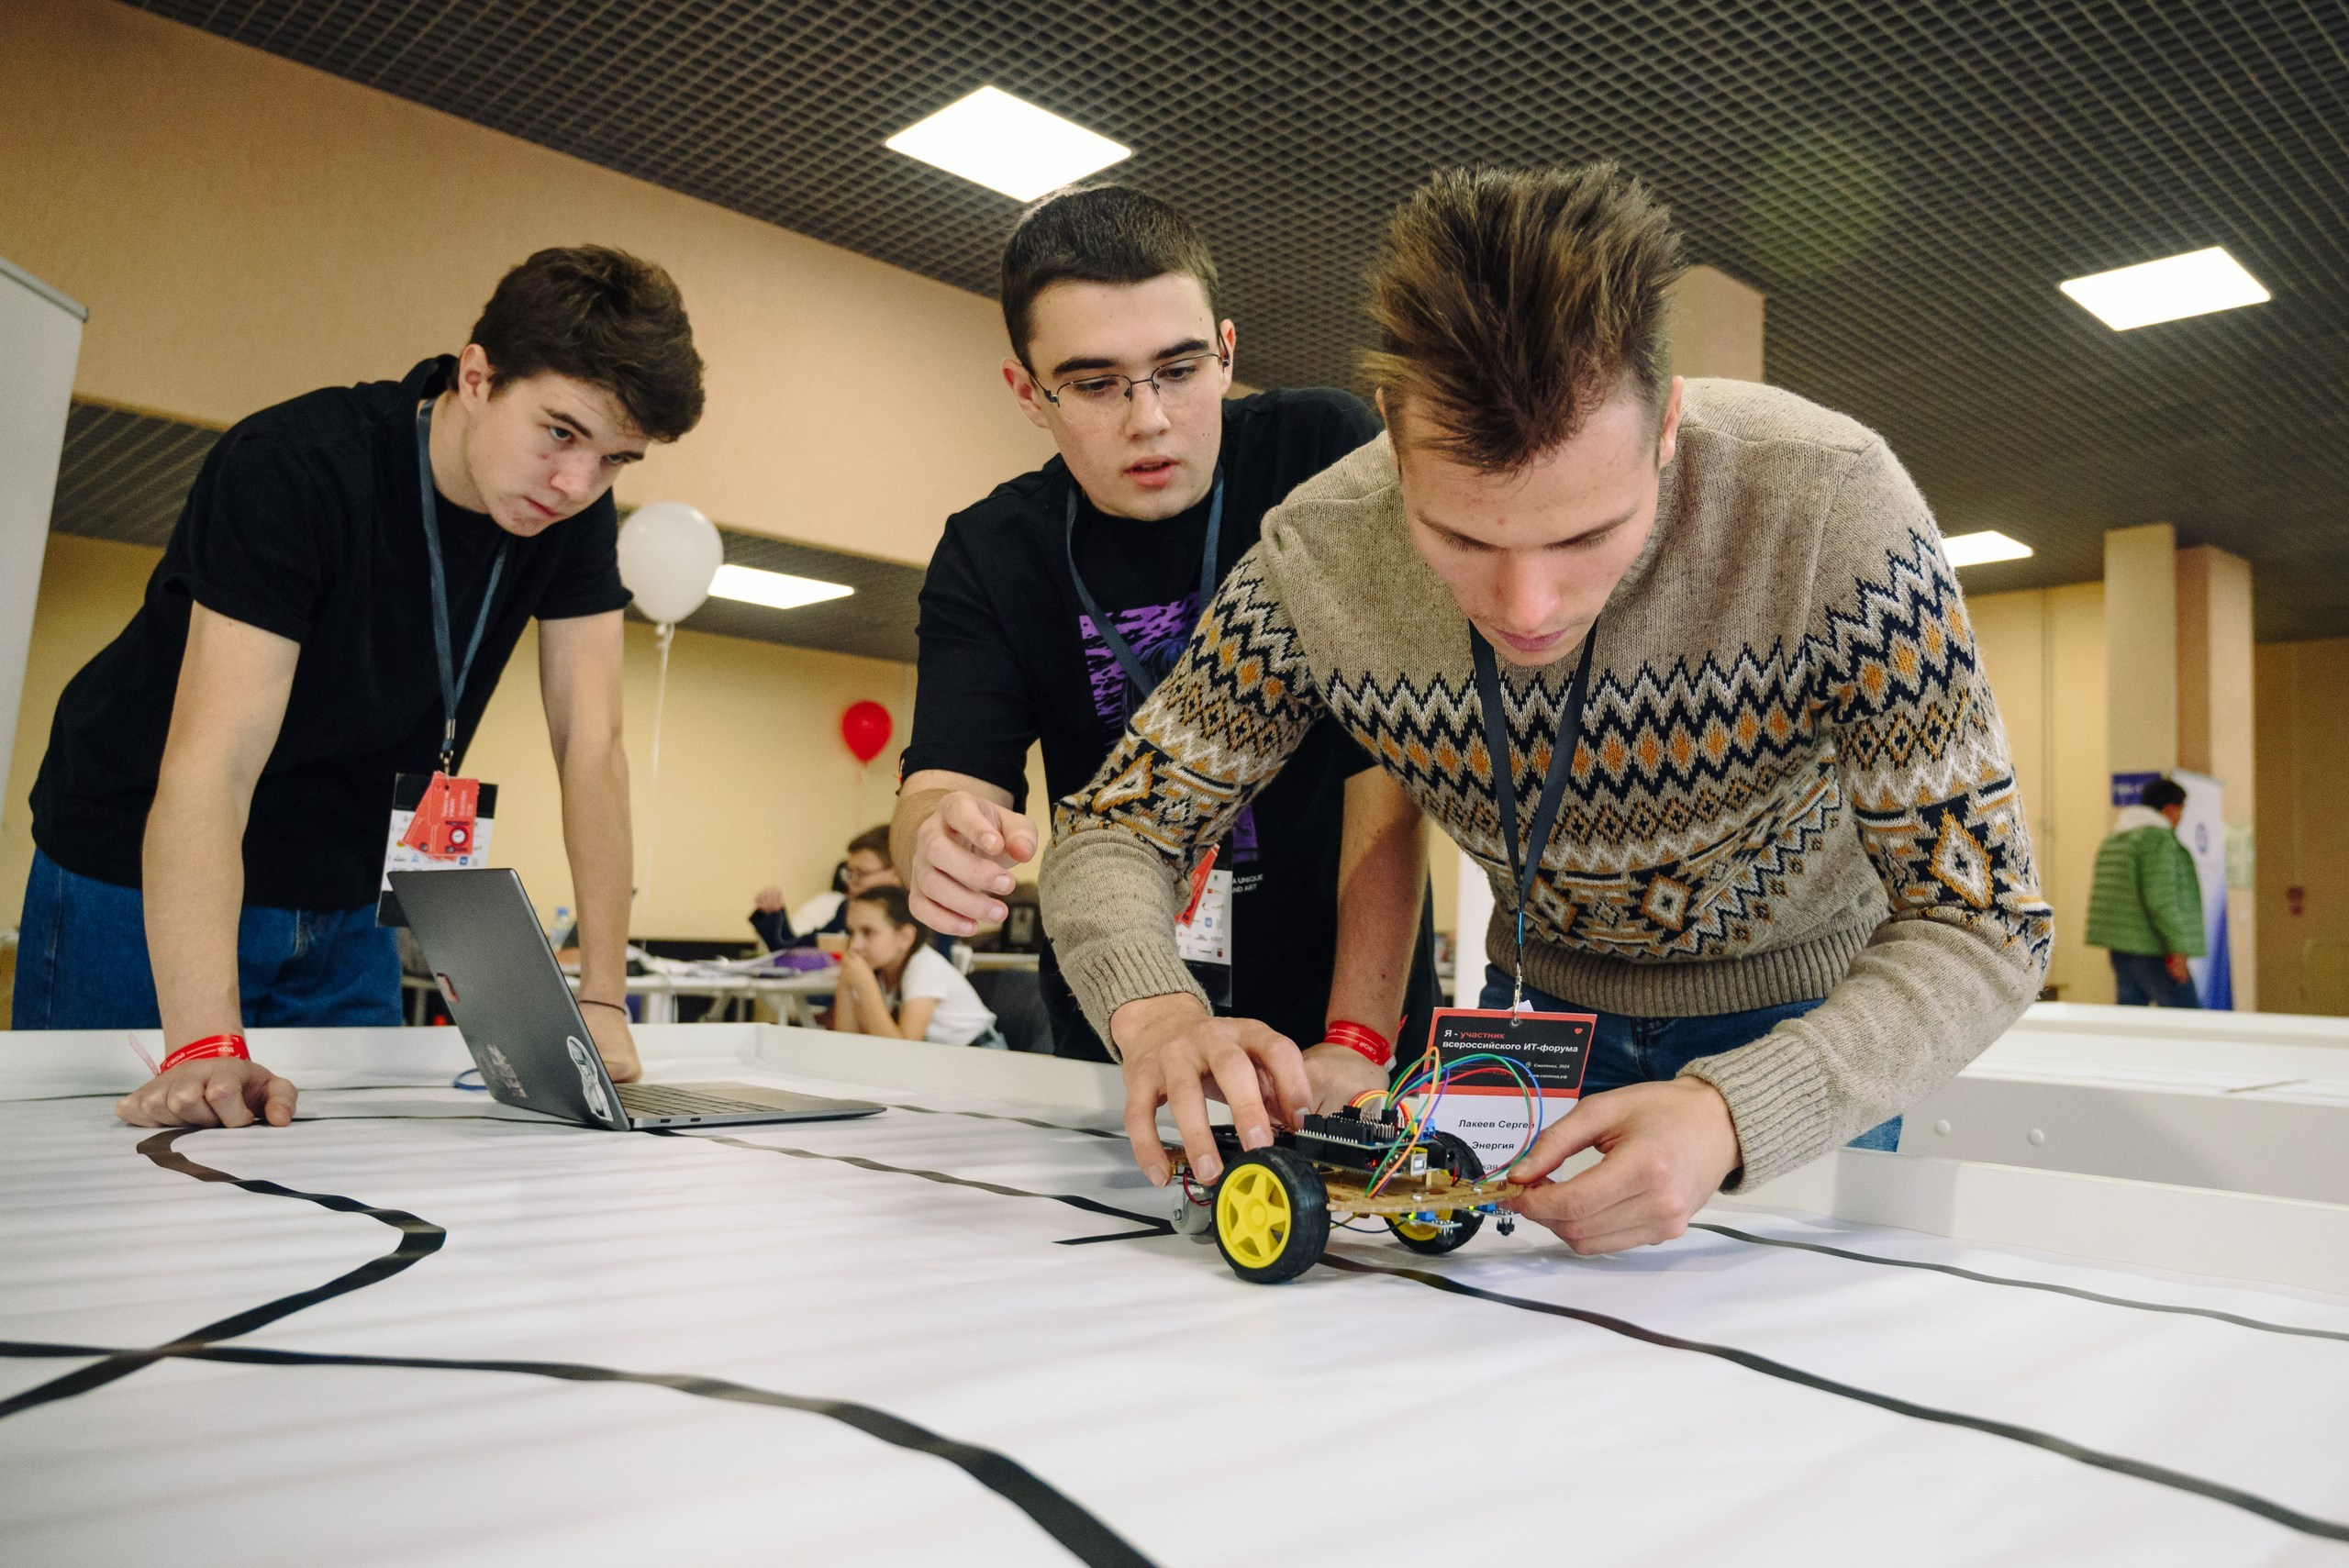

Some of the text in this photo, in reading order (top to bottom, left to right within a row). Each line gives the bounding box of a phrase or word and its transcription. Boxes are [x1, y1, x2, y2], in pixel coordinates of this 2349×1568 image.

[1238, 873, 1264, 884] UNIQUE
[1443, 1029, 1453, 1038] Я
[1460, 1031, 1506, 1040] участник
[1442, 1040, 1578, 1053] всероссийского ИТ-форума
[1458, 1119, 1496, 1129] Лакеев
[1471, 1140, 1515, 1151] Энергия
